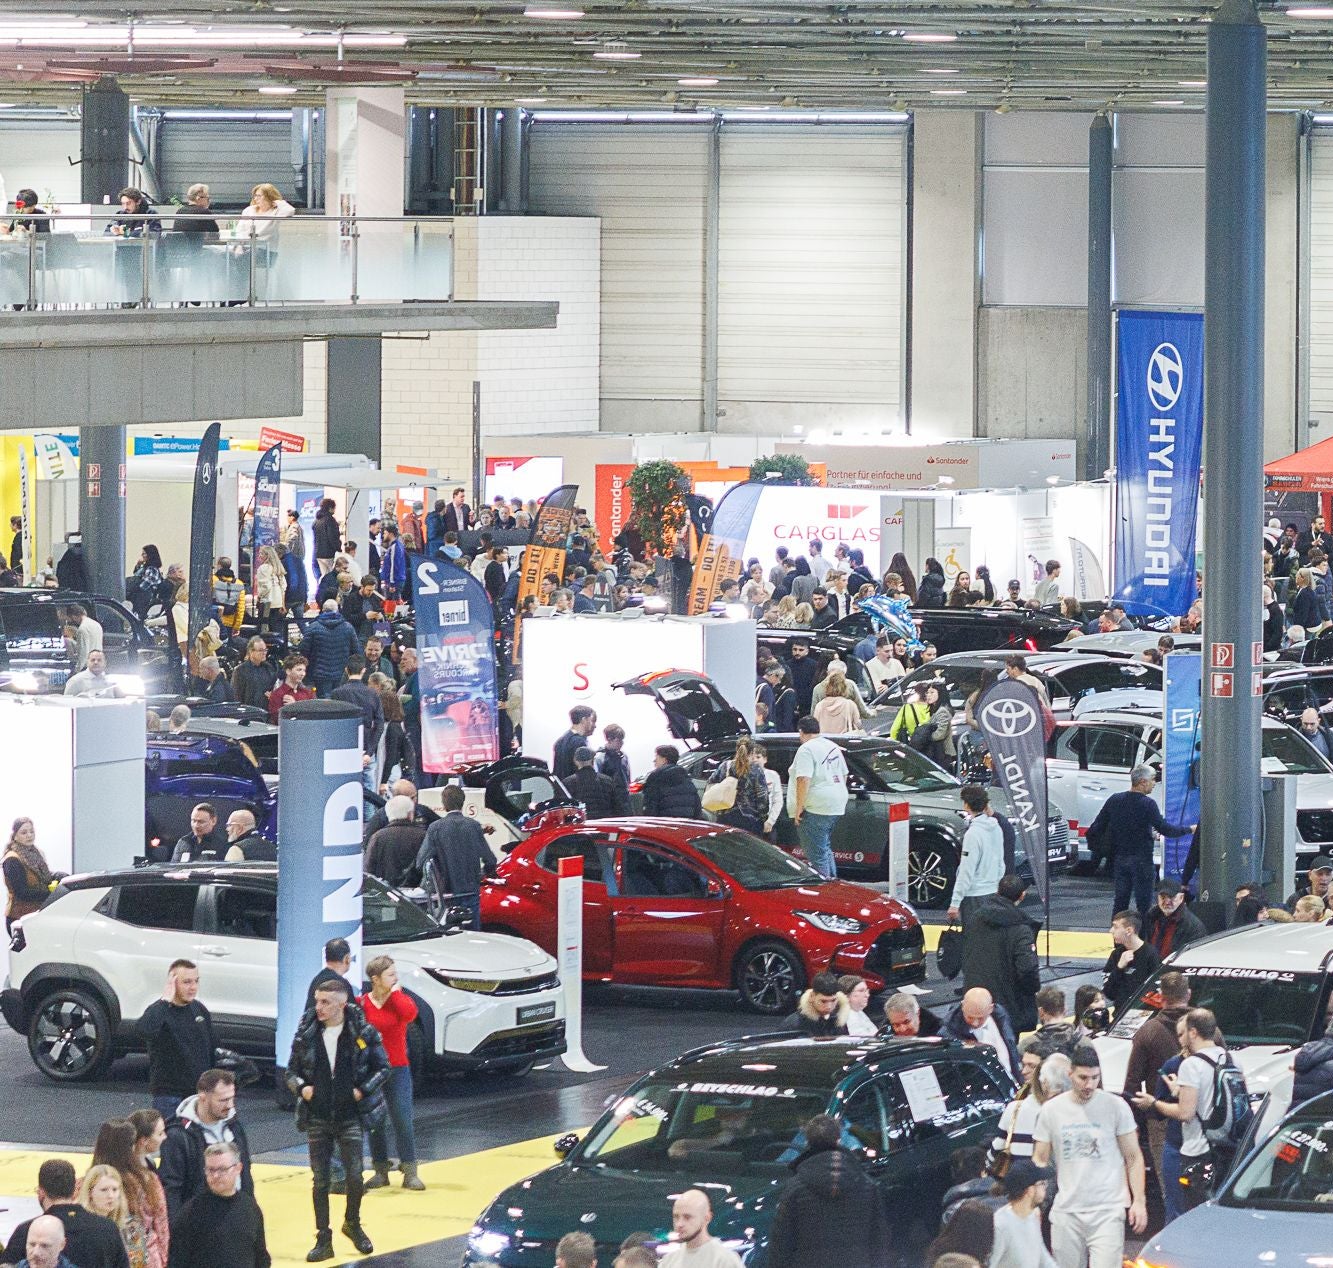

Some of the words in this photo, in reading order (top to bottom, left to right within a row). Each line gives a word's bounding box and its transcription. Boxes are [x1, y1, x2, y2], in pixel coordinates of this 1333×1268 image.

[936, 457, 969, 466] Santander
[827, 470, 857, 480] Partner
[858, 470, 870, 480] für
[871, 471, 905, 481] einfache
[906, 471, 922, 481] und
[1143, 418, 1176, 587] HYUNDAI
[609, 475, 622, 545] antander
[774, 523, 880, 542] CARGLAS
[526, 568, 537, 584] DO
[831, 851, 852, 861] ERVICE
[1197, 967, 1279, 980] BEYSCHLAG
[691, 1083, 778, 1097] BEYSCHLAG
